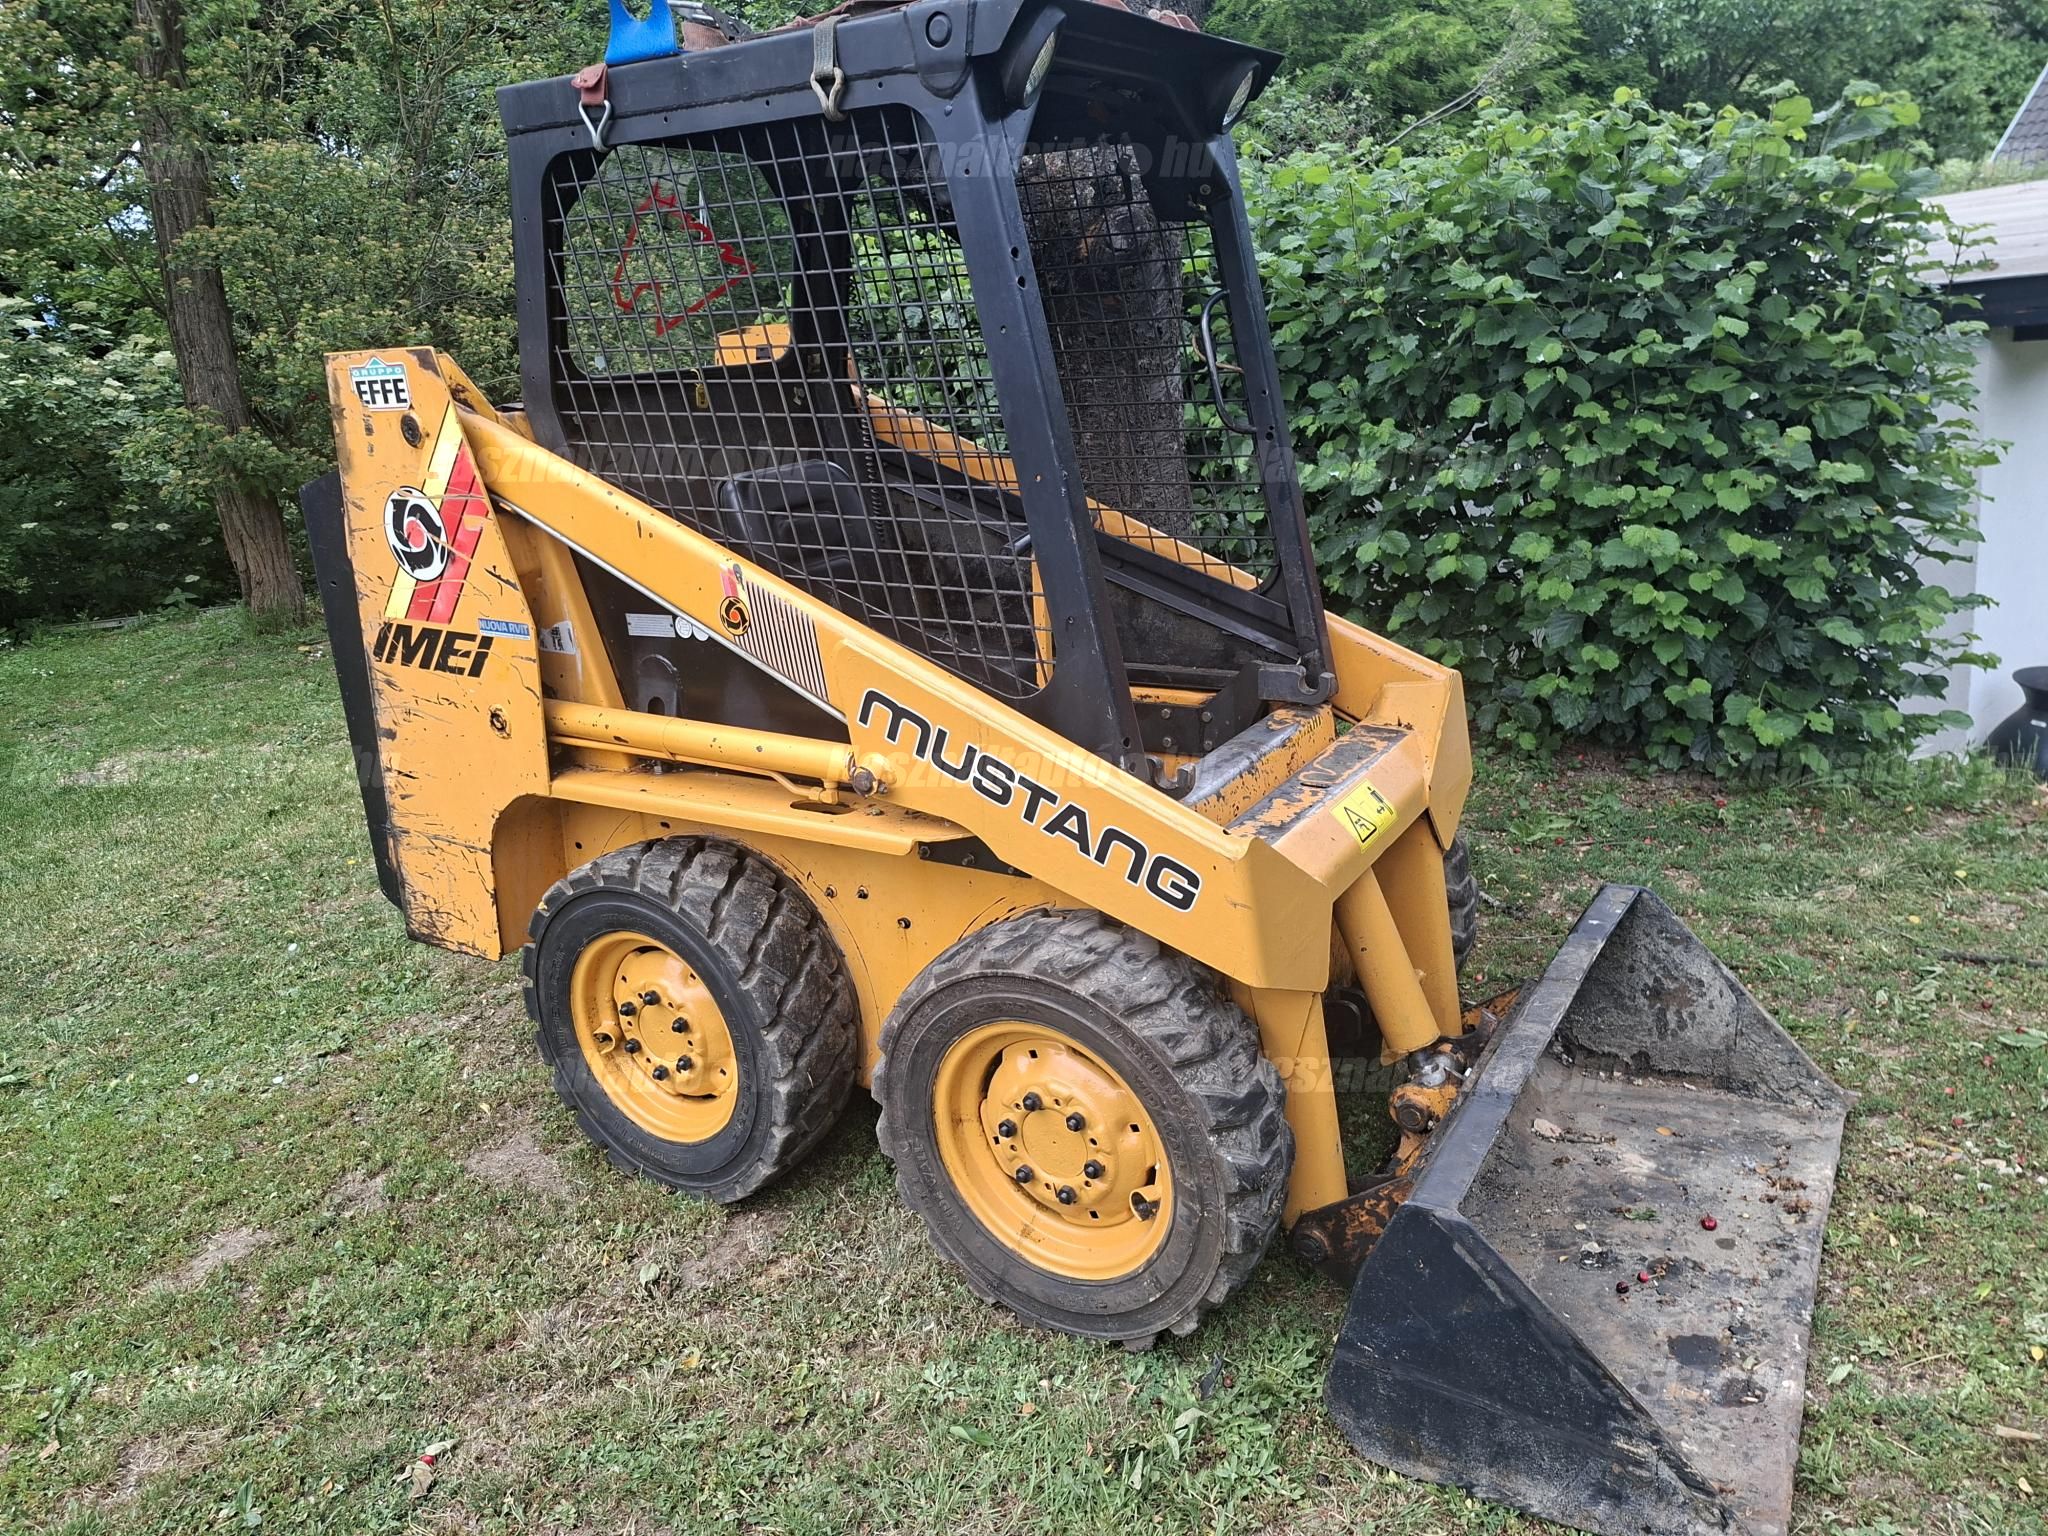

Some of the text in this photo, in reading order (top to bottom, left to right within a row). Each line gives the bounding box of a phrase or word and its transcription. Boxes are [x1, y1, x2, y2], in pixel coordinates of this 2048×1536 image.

[352, 367, 402, 377] GRUPPO
[355, 379, 408, 404] EFFE
[479, 620, 529, 634] NUOVA RVIT
[373, 624, 494, 677] IMEI
[858, 689, 1202, 911] MUSTANG
